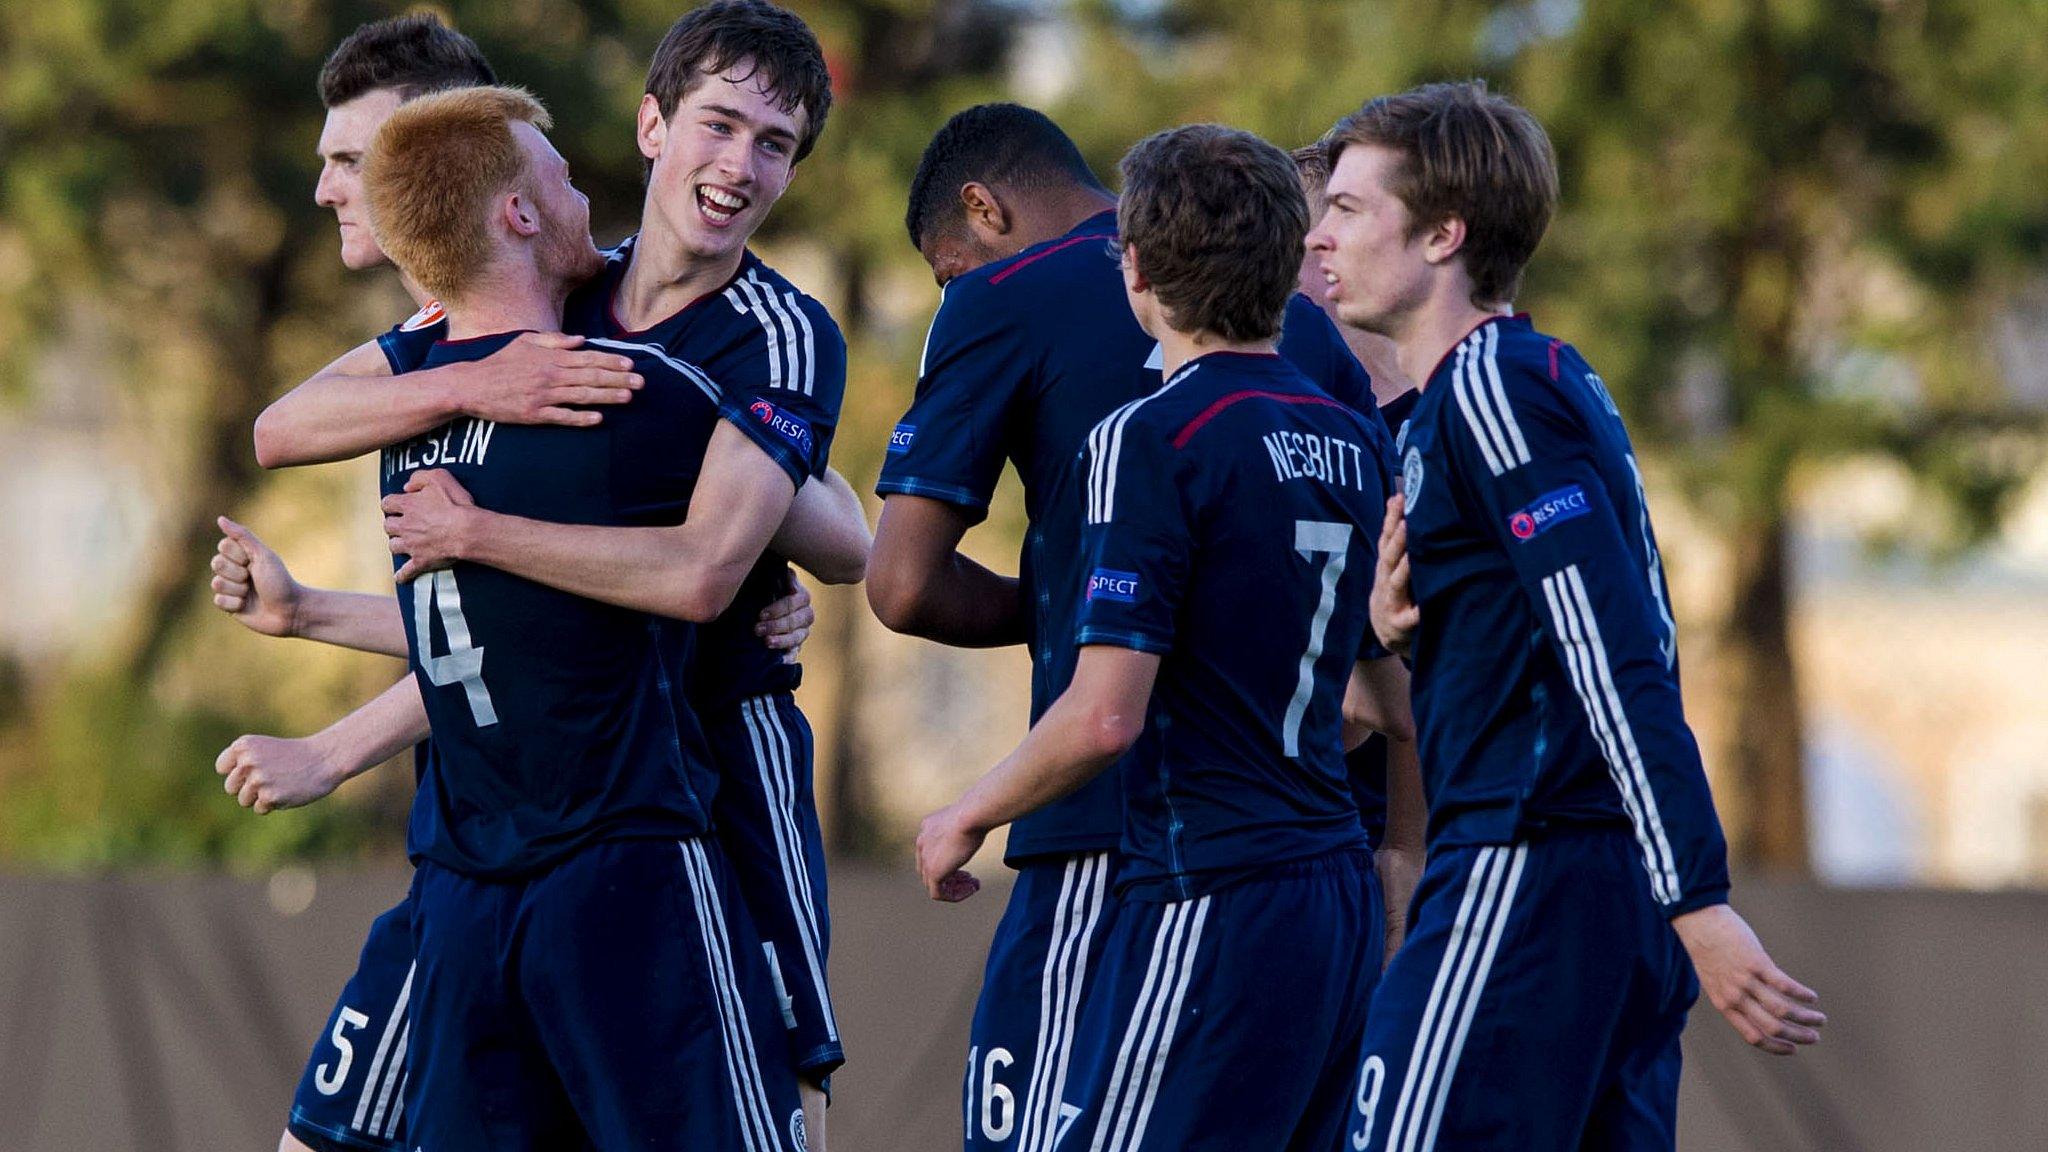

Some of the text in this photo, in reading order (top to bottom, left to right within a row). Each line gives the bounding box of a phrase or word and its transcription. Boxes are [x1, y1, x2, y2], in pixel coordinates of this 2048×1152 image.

[771, 415, 812, 452] RESP
[1262, 431, 1363, 491] NESBITT
[1532, 491, 1586, 525] RESPECT
[1091, 576, 1138, 595] SPECT
[413, 569, 499, 728] 4
[1283, 520, 1354, 757] 7
[314, 1005, 370, 1096] 5
[966, 1045, 1015, 1142] 16
[1352, 1054, 1386, 1152] 9
